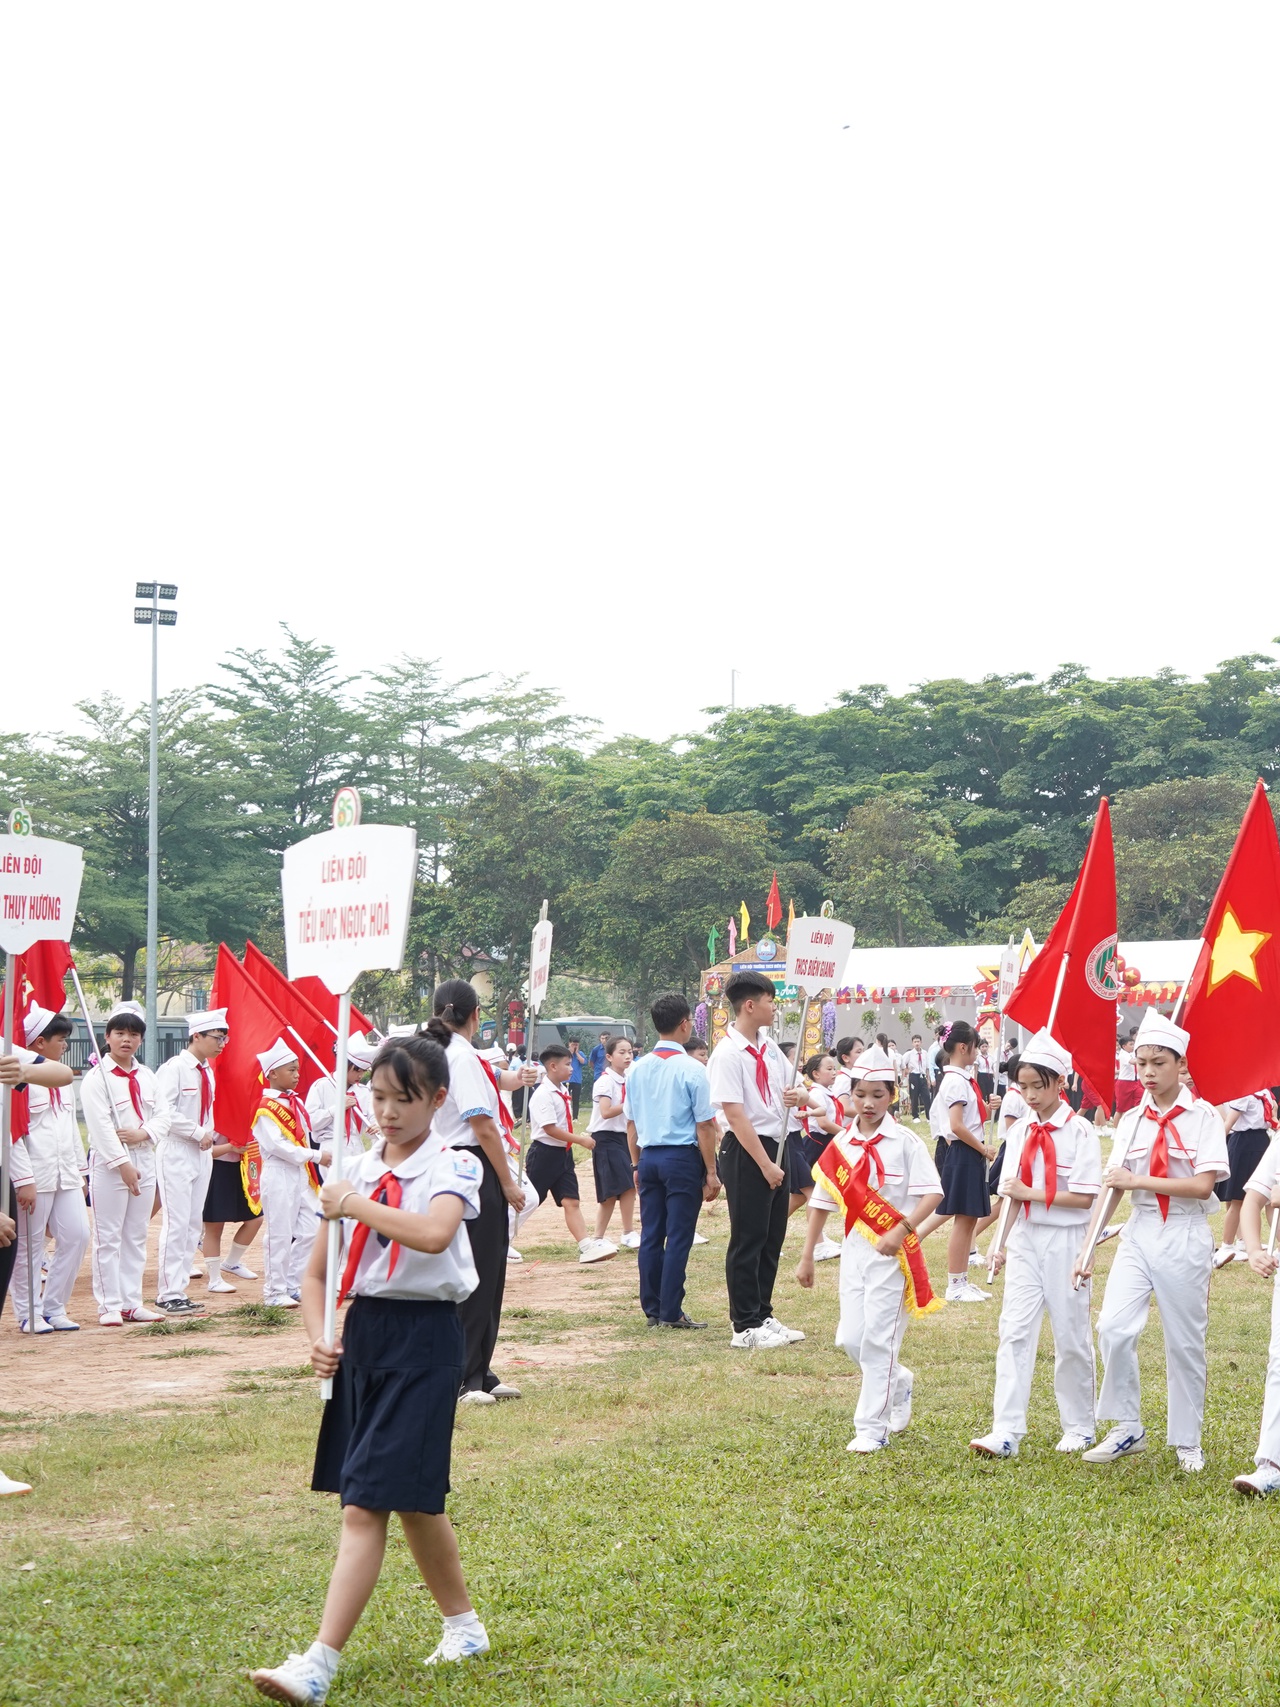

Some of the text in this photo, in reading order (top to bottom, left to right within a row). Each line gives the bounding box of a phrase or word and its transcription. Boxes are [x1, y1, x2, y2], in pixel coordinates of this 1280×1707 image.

[13, 811, 30, 836] 85
[338, 797, 353, 828] 85
[0, 853, 42, 879] IÊN ĐỘI
[322, 851, 367, 885] LIÊN ĐỘI
[29, 893, 61, 921] HƯƠNG
[319, 907, 337, 950] HỌC
[340, 903, 366, 947] NGỌC
[810, 930, 835, 948] LIÊN ĐỘI
[795, 956, 836, 978] THCS BIÊN GIANG
[266, 1100, 279, 1111] ĐỘI
[835, 1164, 850, 1187] ĐỘI
[863, 1199, 884, 1219] HỒ
